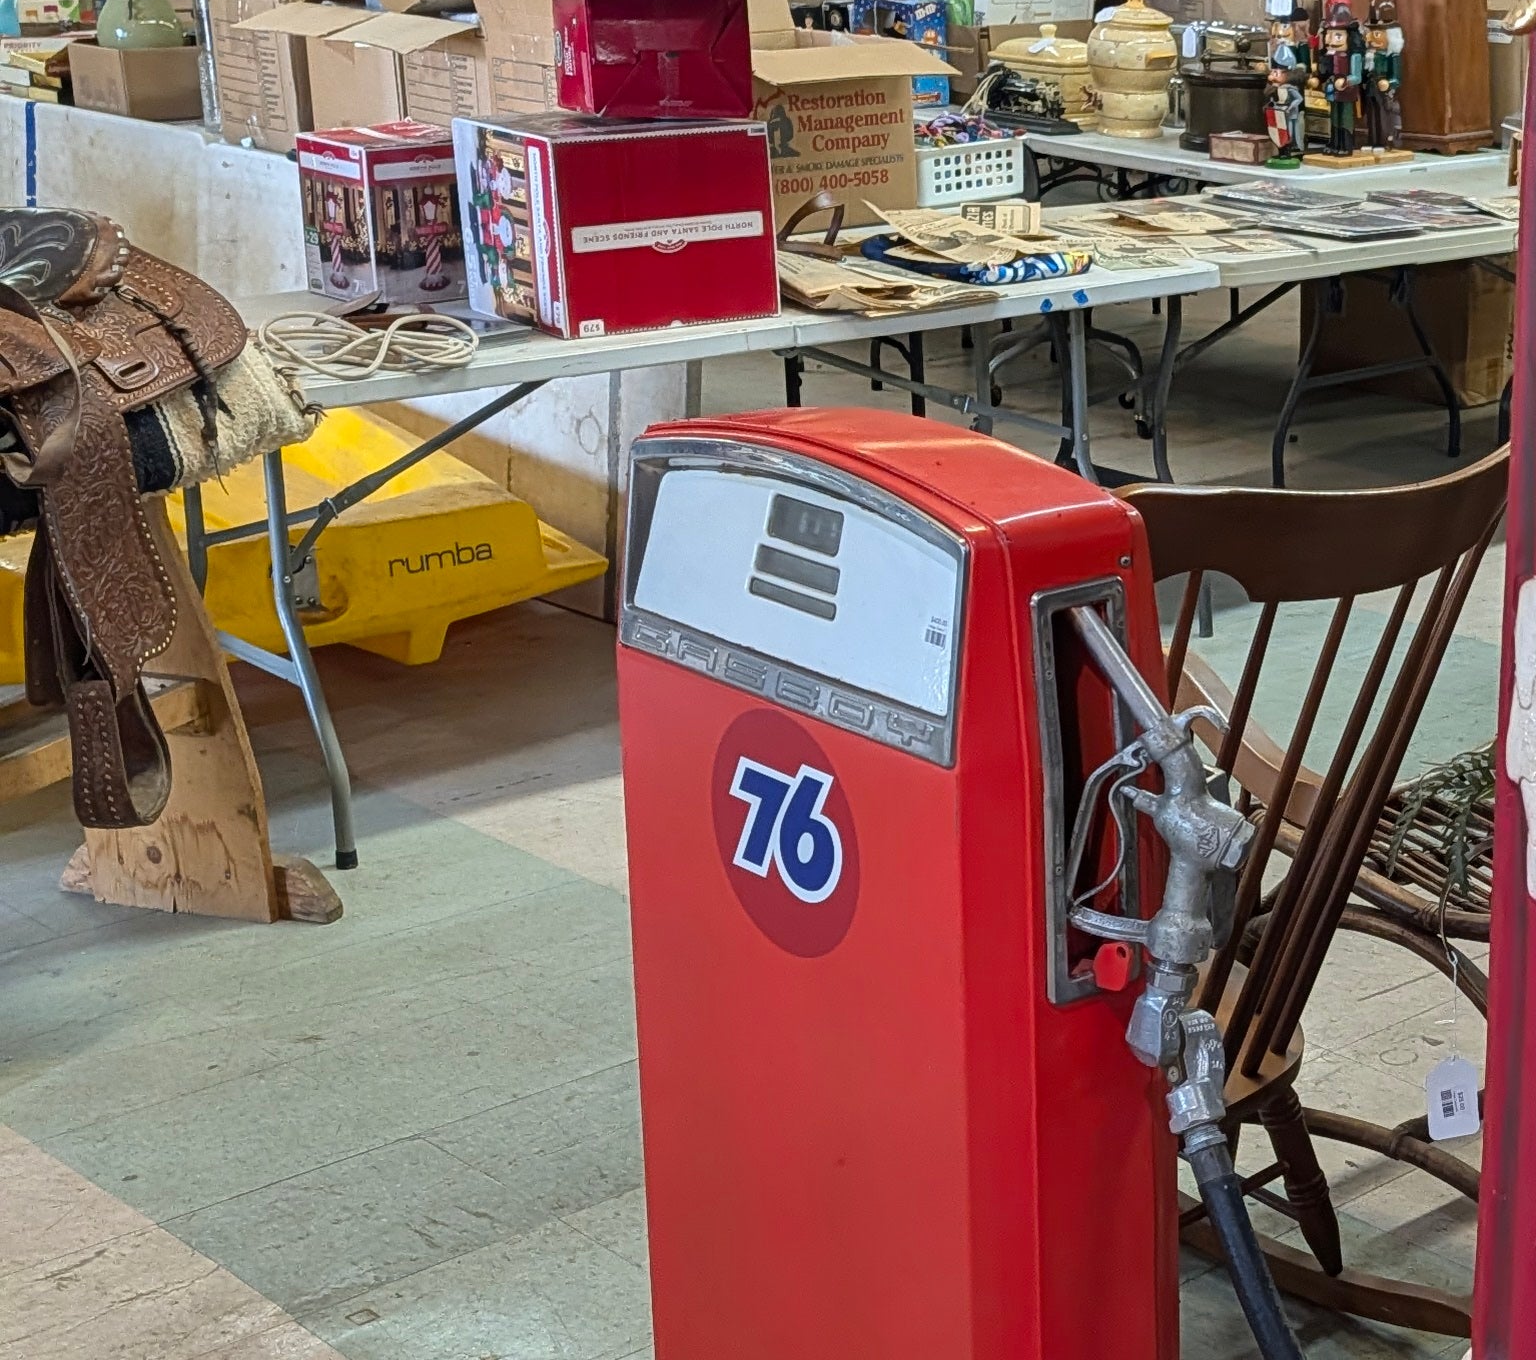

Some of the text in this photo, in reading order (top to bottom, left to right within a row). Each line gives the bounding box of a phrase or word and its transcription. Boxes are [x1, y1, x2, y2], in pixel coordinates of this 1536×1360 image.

[787, 89, 886, 112] Restoration
[797, 108, 905, 133] Management
[812, 132, 890, 154] Company
[825, 157, 859, 169] DAMAGE
[775, 169, 889, 195] (800) 400-5058
[671, 225, 699, 235] SANTA
[701, 223, 723, 233] POLE
[725, 221, 753, 230] NORTH
[583, 234, 611, 244] SCENE
[613, 231, 648, 241] FRIENDS
[652, 229, 668, 238] AND
[583, 323, 601, 333] $79
[388, 542, 493, 577] rumba
[631, 620, 936, 747] GASBOY
[729, 756, 843, 904] 76
